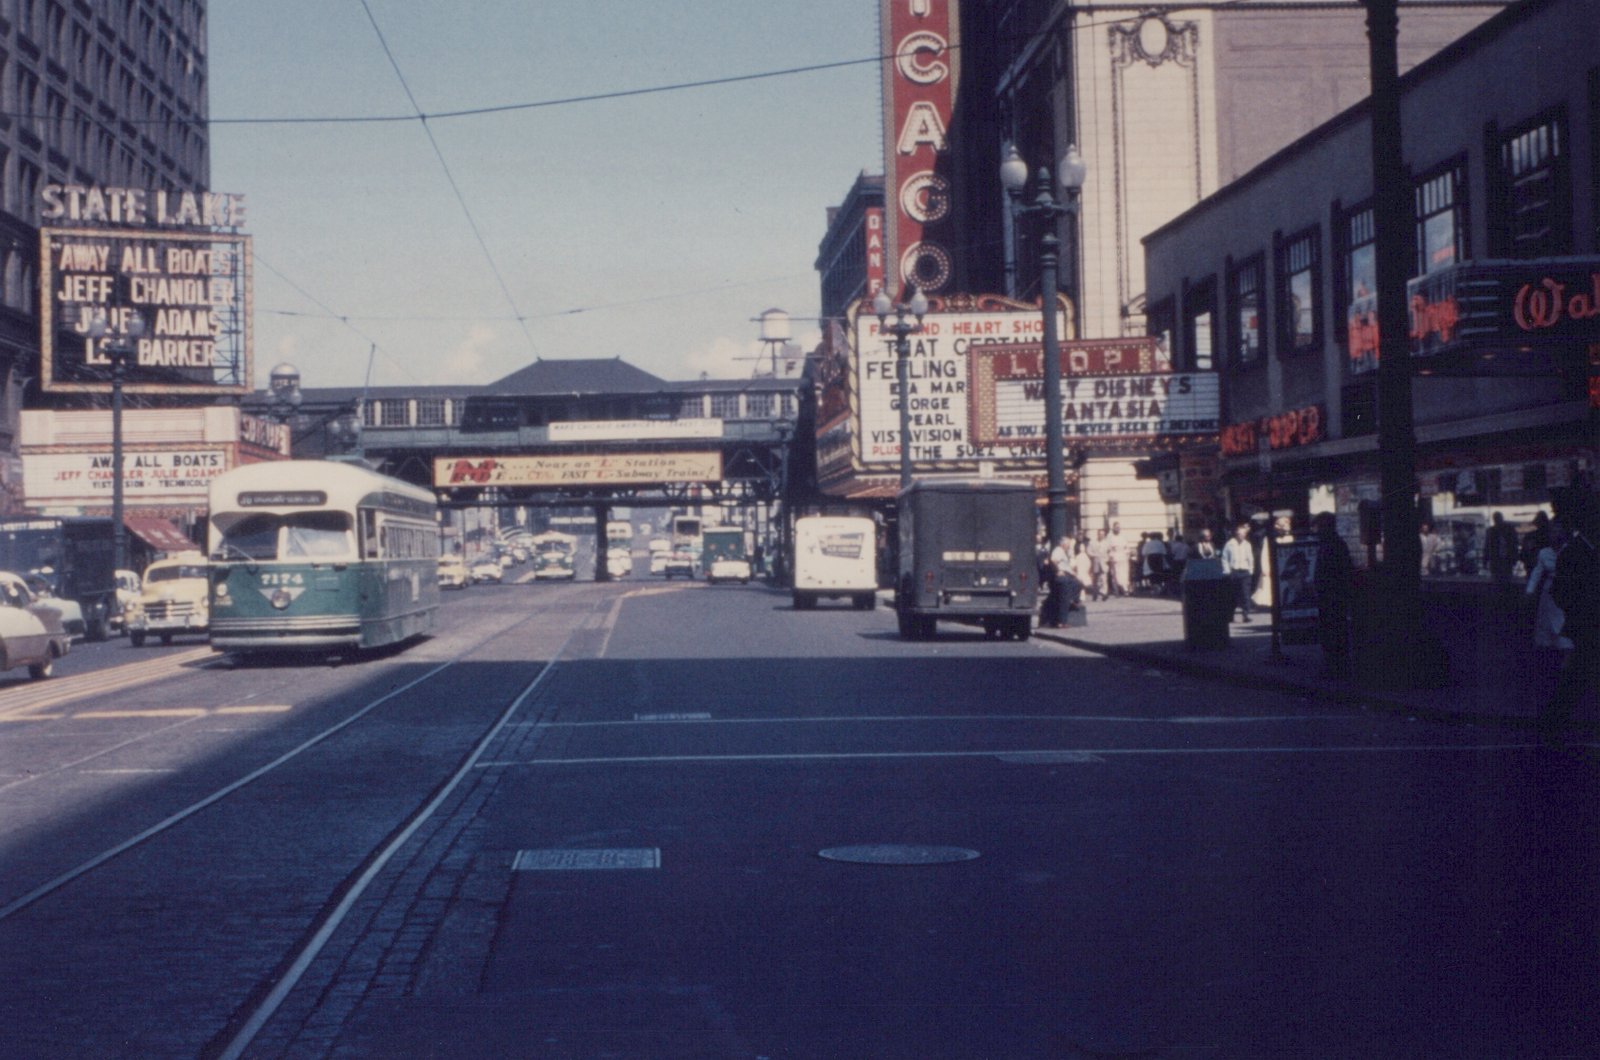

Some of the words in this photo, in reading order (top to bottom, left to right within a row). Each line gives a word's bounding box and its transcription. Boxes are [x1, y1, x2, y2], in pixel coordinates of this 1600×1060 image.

[41, 184, 146, 224] STATE
[156, 188, 247, 227] LAKE
[121, 246, 161, 273] ALL
[58, 275, 115, 303] JEFF
[131, 277, 235, 307] CHANDLER
[75, 306, 131, 334] JLIE
[155, 309, 223, 336] ADAMS
[952, 320, 1002, 335] HEART
[1013, 319, 1045, 334] SHO
[86, 338, 125, 366] LE
[138, 339, 217, 366] BARKER
[890, 382, 918, 395] EA
[1023, 380, 1079, 401] WAT
[1094, 376, 1192, 399] DISNEY'S
[890, 398, 950, 411] GORGE
[998, 426, 1012, 437] AS
[1017, 424, 1037, 436] YOU
[1075, 422, 1112, 435] NEVER
[1117, 421, 1149, 433] SEEN
[872, 445, 902, 456] PLUS
[957, 445, 996, 457] SUEZ
[134, 455, 161, 467] ALL
[535, 460, 568, 470] Near
[625, 458, 677, 468] Station
[53, 470, 82, 481] JEFF
[88, 469, 145, 480] CHANLER
[149, 468, 179, 479] JULIE
[185, 467, 224, 478] ADAMS
[561, 469, 589, 480] FAST
